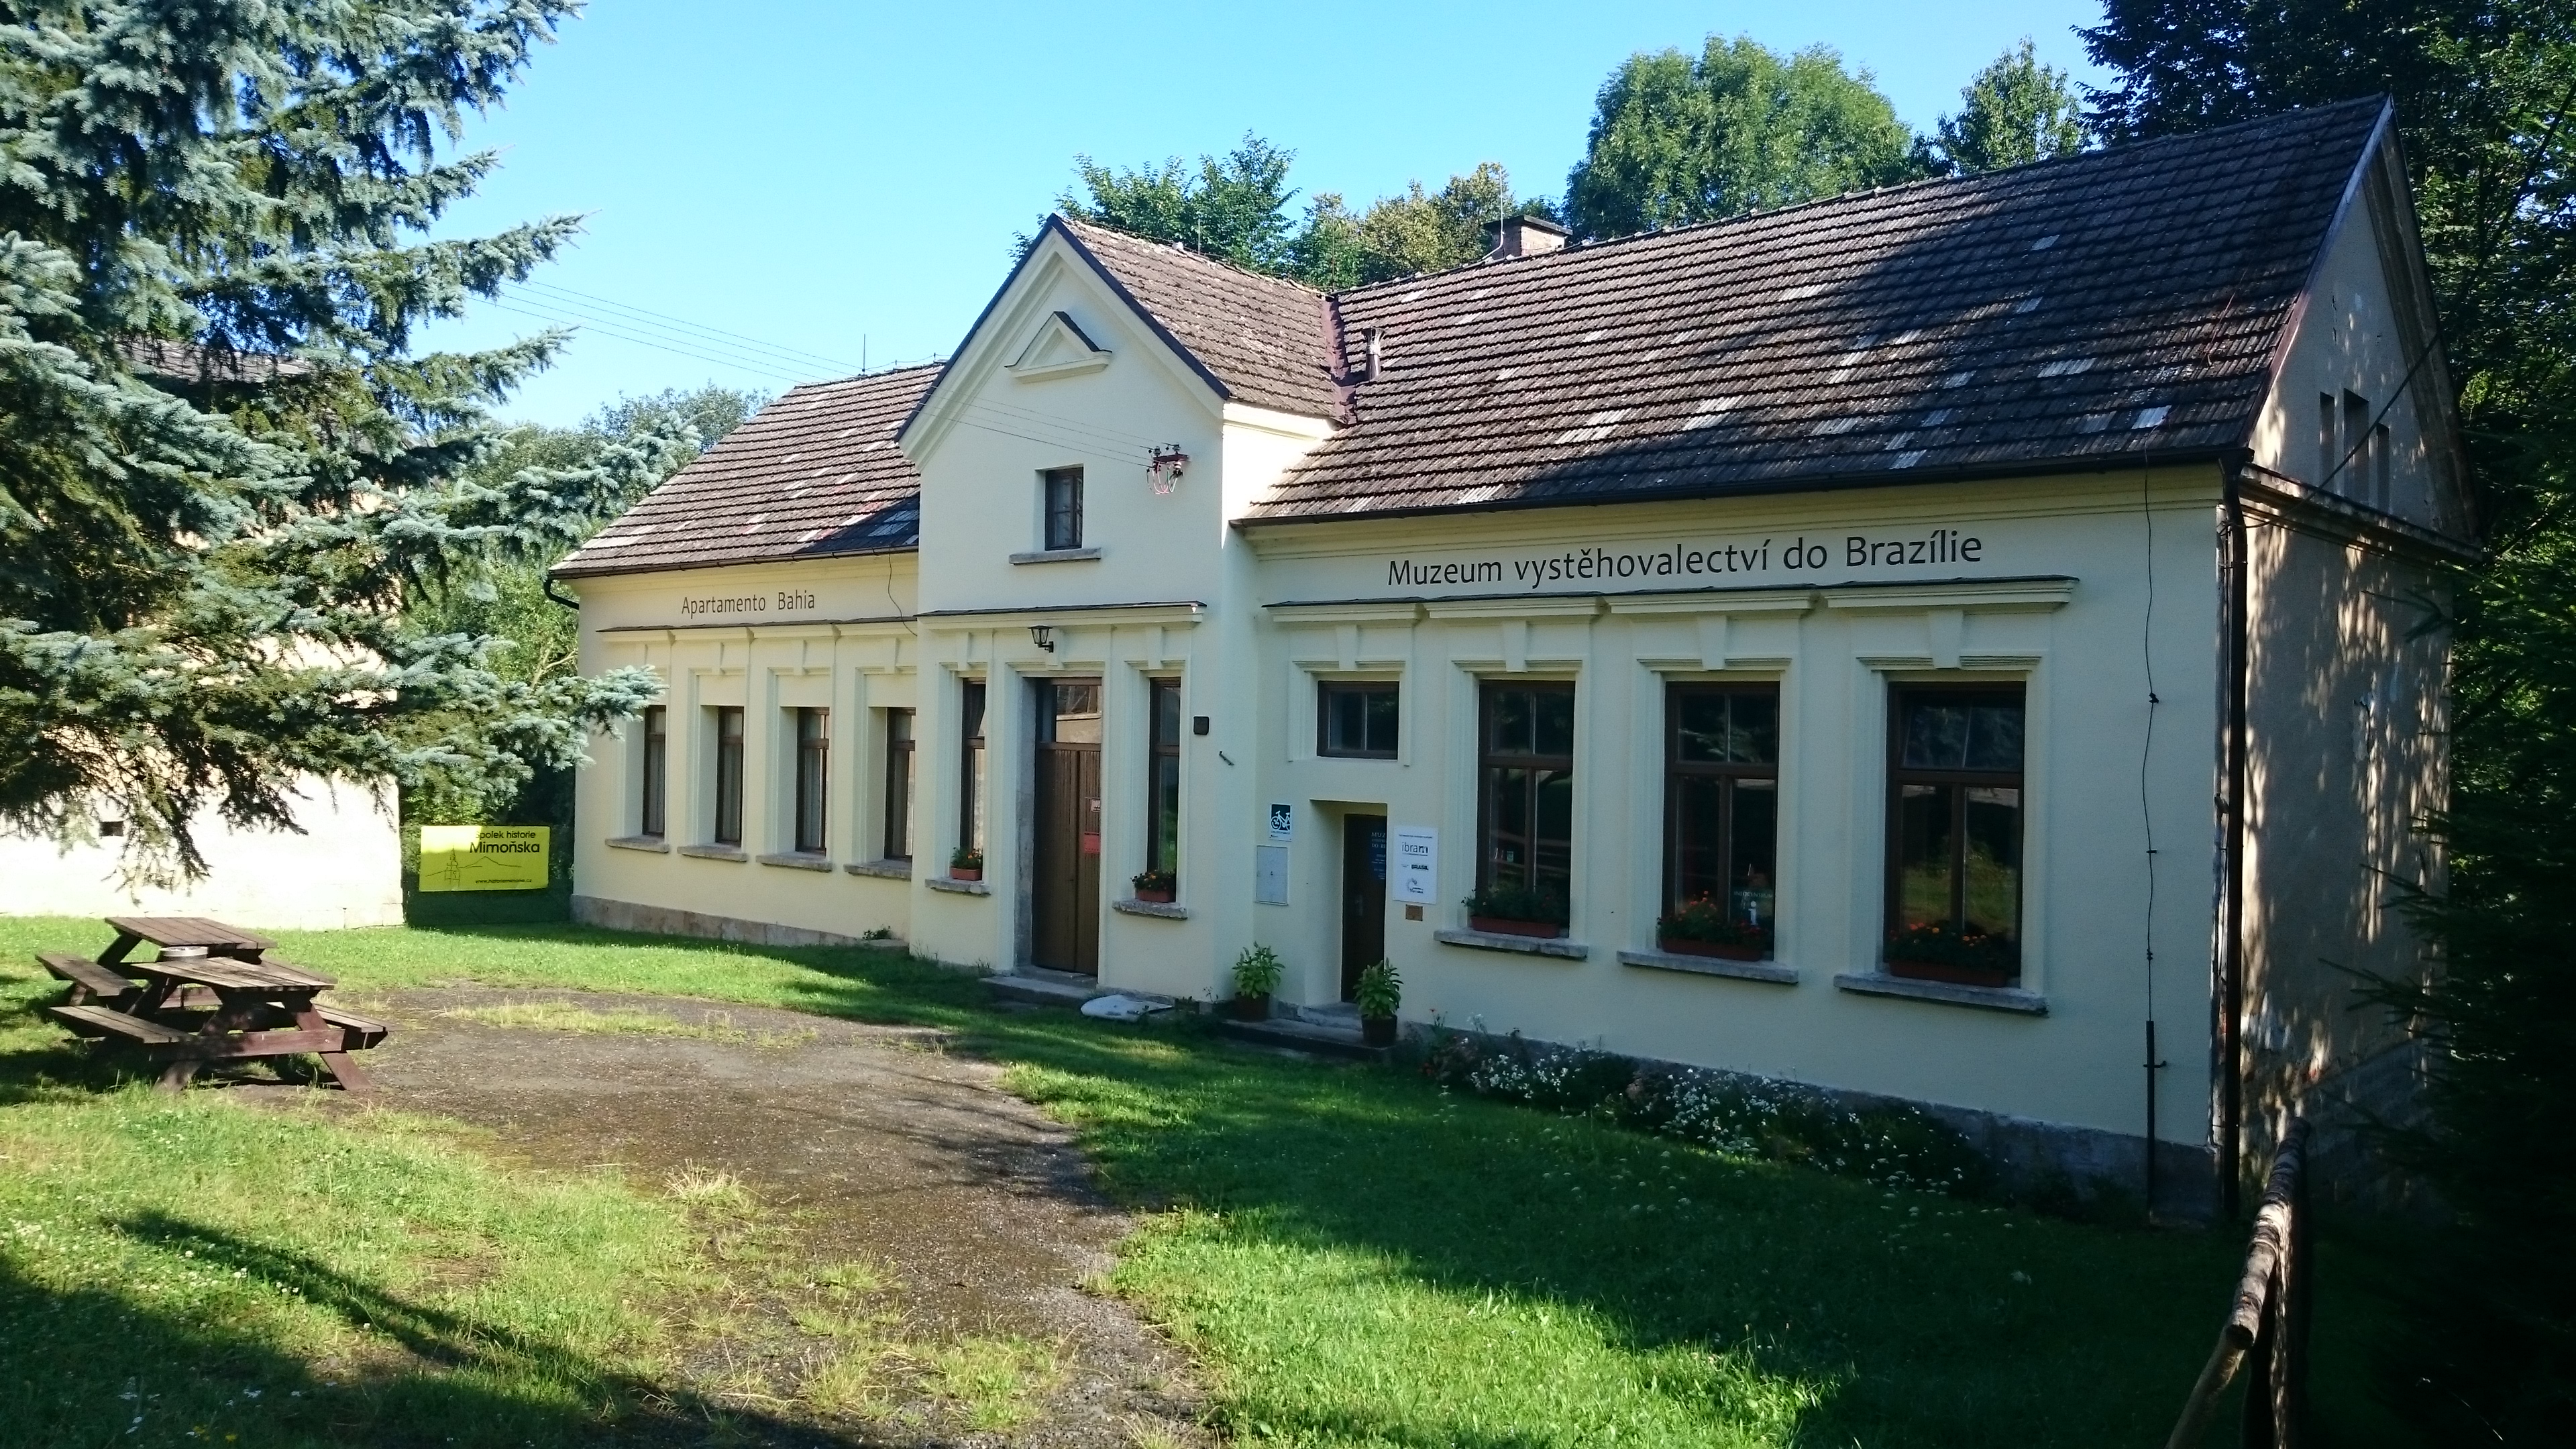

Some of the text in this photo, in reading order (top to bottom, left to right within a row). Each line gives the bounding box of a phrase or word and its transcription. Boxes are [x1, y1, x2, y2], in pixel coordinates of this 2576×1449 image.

[1388, 529, 1982, 589] Muzeum vystěhovalectví do Brazílie
[682, 589, 815, 619] Apartamento Bahia
[476, 830, 536, 840] Spolek historie
[470, 841, 540, 853] Mimoňska
[1402, 841, 1428, 853] ibram
